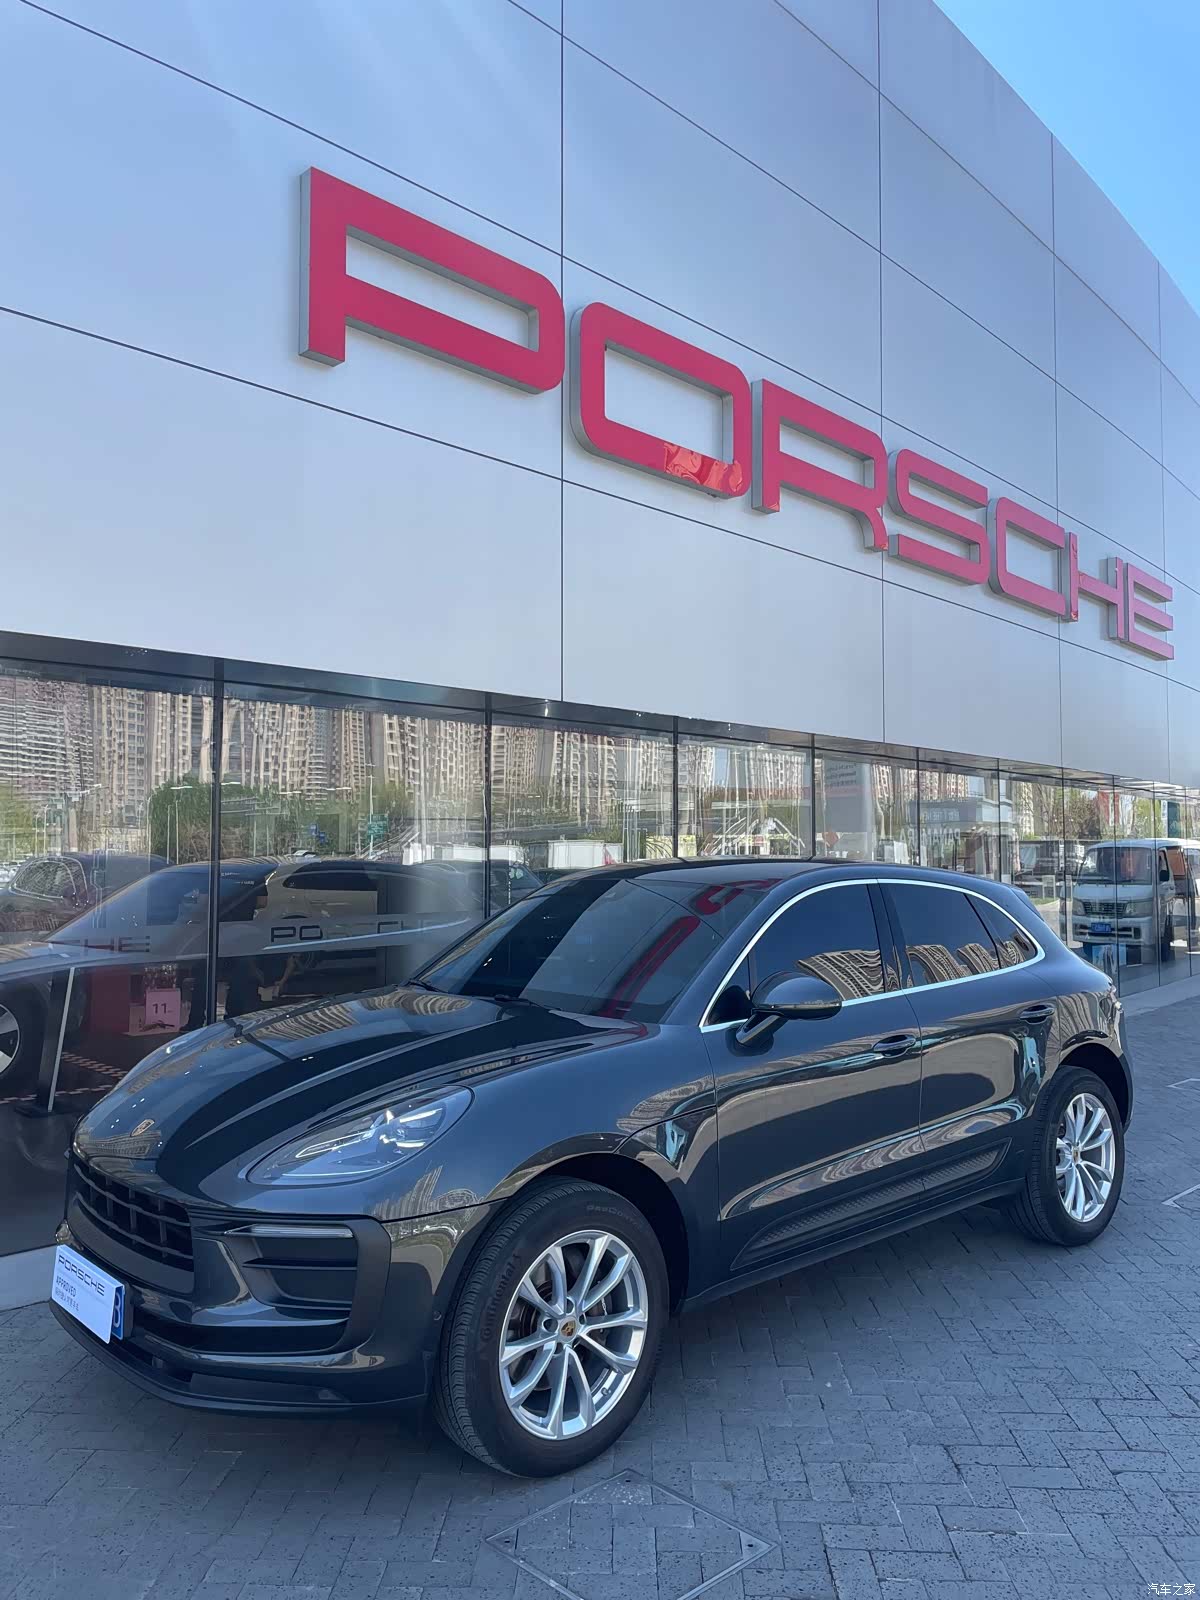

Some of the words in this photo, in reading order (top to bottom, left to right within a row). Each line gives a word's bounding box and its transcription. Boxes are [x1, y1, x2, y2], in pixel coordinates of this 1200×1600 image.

[299, 166, 1175, 661] PORSCHE
[56, 1275, 77, 1298] APPROVED
[58, 1254, 105, 1297] PORSCHE
